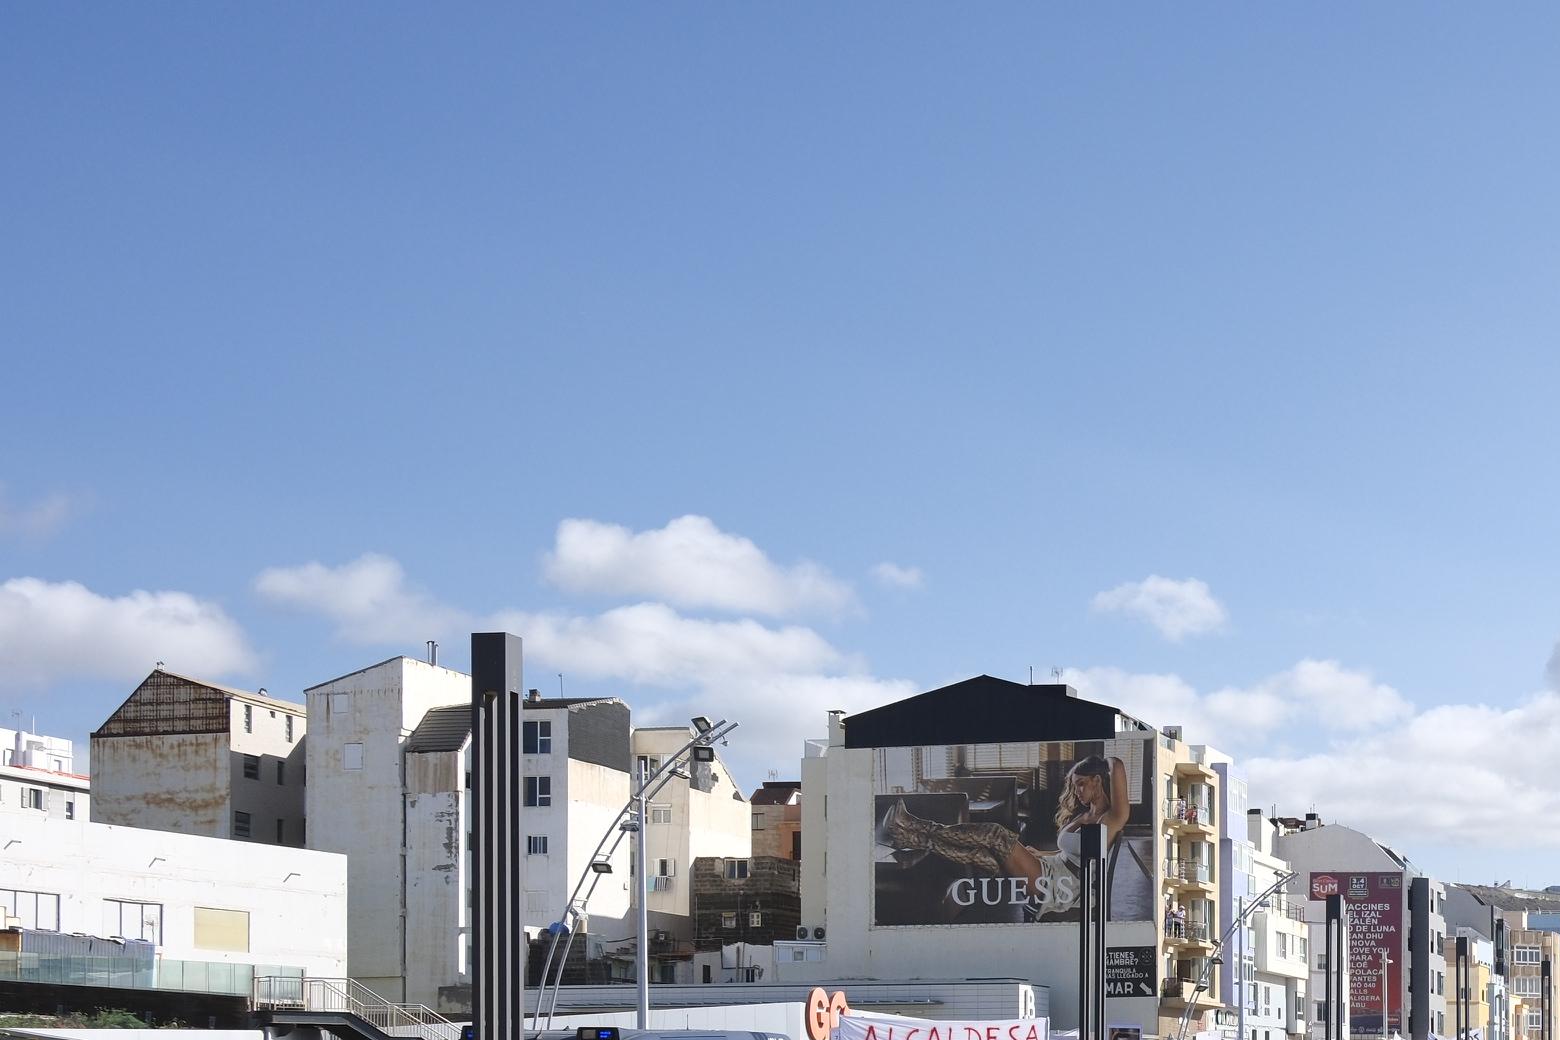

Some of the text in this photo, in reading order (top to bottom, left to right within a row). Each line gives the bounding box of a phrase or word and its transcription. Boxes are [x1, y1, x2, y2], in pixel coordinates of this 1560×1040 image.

[951, 876, 1074, 906] GUESS
[1349, 917, 1378, 925] ZALÉN
[1106, 982, 1134, 995] MAR
